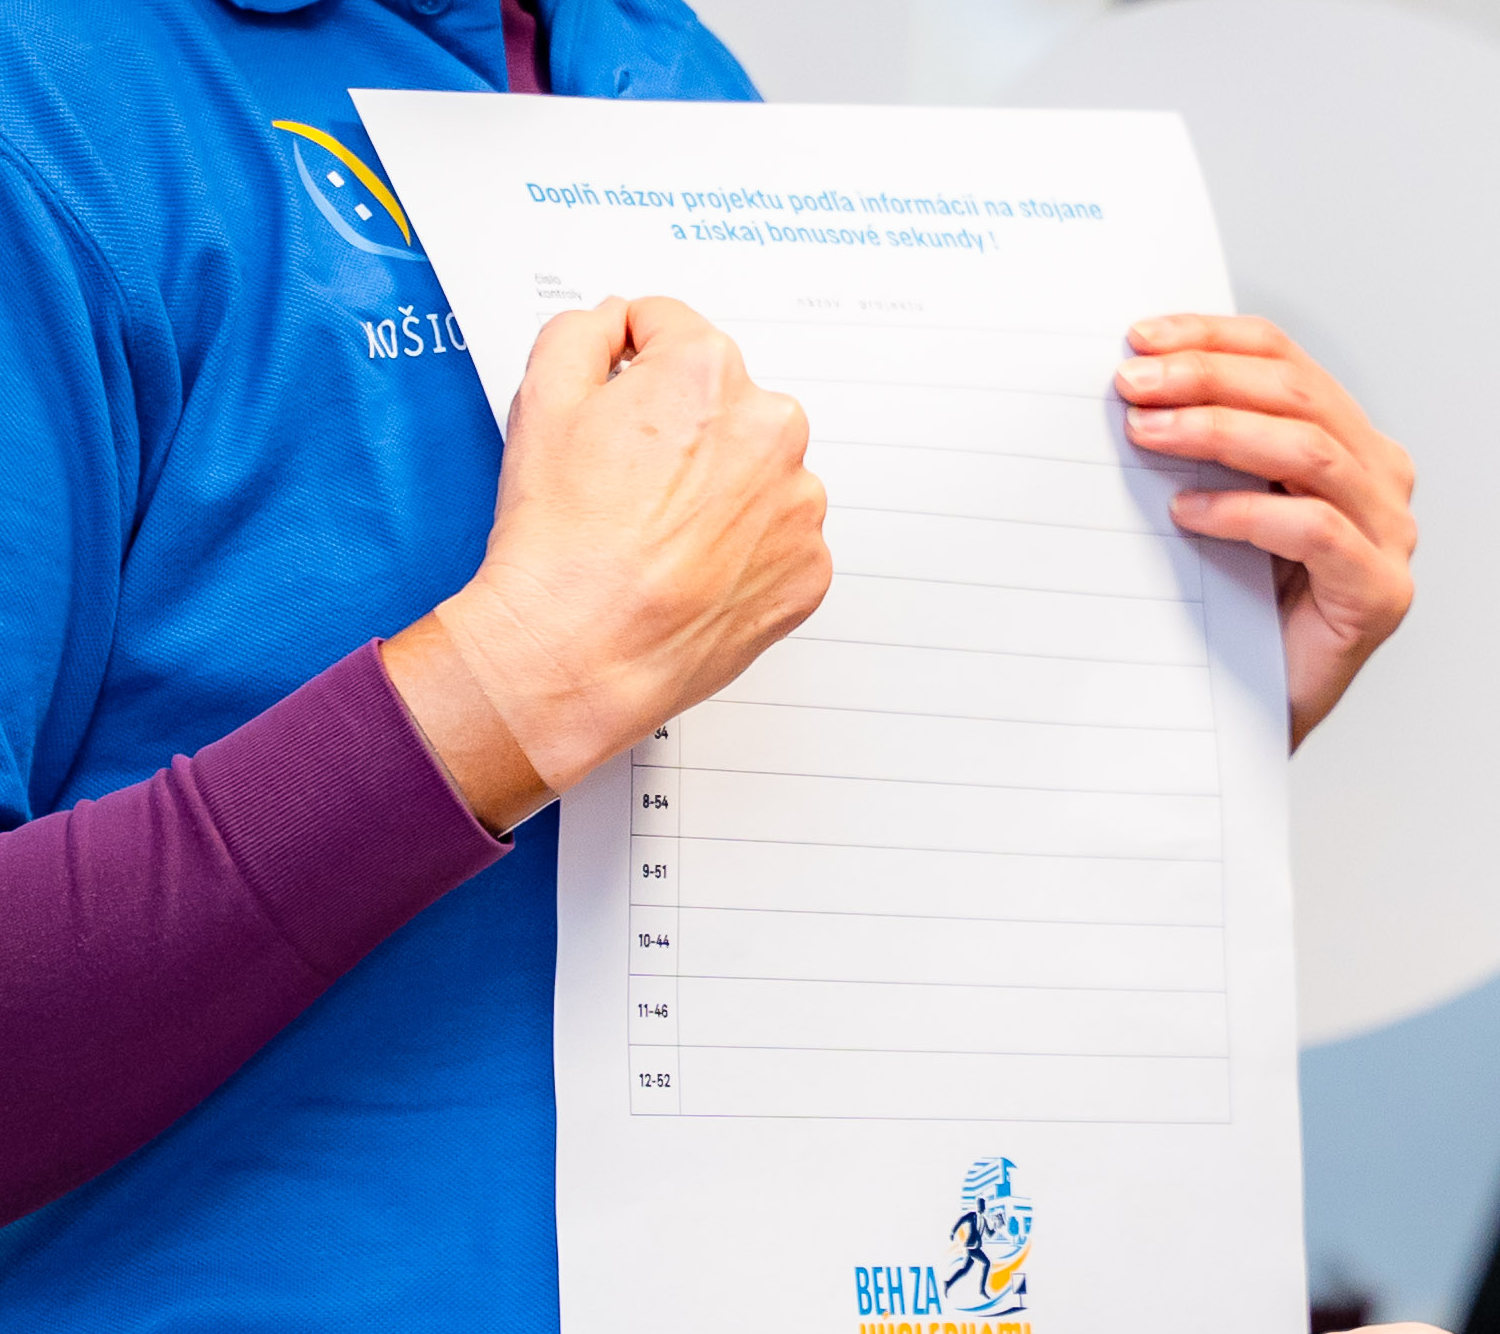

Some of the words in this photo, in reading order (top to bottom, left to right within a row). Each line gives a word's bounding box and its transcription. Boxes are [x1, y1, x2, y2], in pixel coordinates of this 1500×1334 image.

[525, 182, 601, 209] Doplň
[603, 184, 675, 208] názov
[679, 186, 784, 214] projektu
[786, 188, 856, 215] podľa
[983, 199, 1015, 218] na
[1018, 196, 1105, 223] stojane
[670, 222, 688, 241] a
[764, 220, 882, 248] bonusové
[884, 224, 985, 254] sekundy
[358, 304, 468, 359] KOŠIC
[642, 793, 669, 809] 8-54
[642, 864, 667, 879] 9-51
[638, 934, 670, 948] 10-44
[637, 1003, 669, 1018] 11-46
[638, 1073, 671, 1088] 12-52
[854, 1265, 906, 1316] BEH
[908, 1265, 943, 1316] ZA
